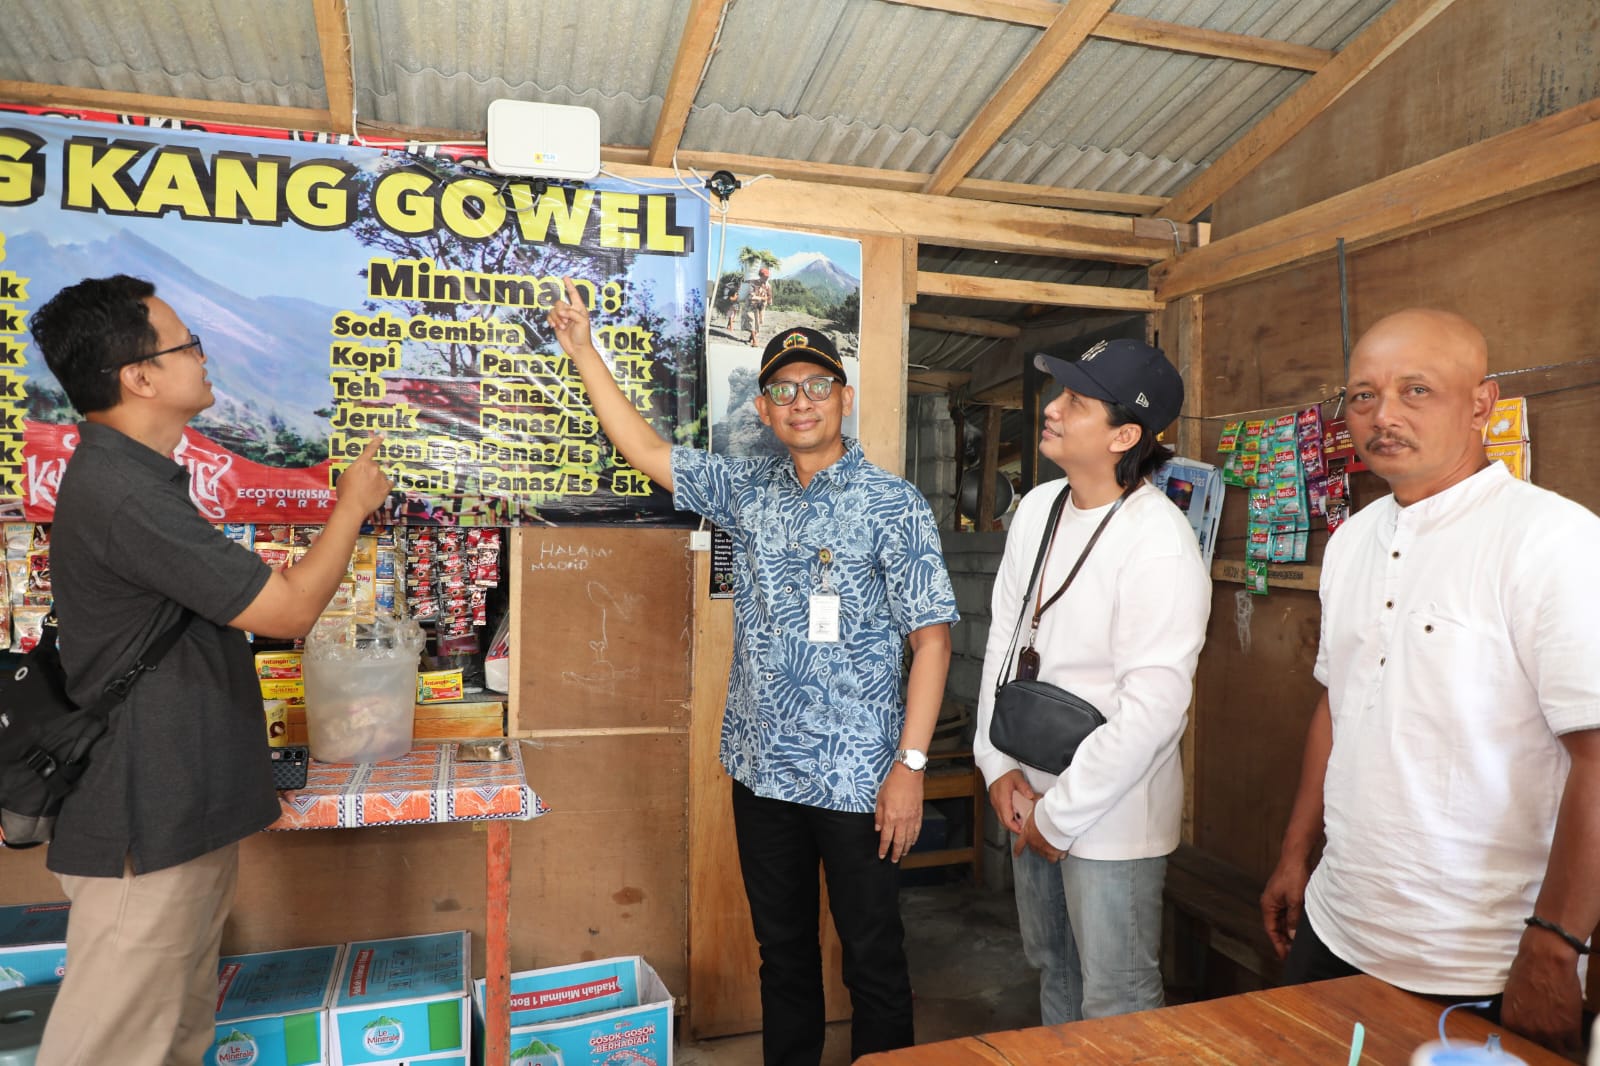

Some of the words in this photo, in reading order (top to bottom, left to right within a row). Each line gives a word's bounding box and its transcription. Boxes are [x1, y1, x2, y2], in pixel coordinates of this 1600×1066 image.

[64, 139, 352, 230] KANG
[374, 170, 688, 253] GOWEL
[334, 316, 401, 337] Soda
[409, 320, 520, 344] Gembira
[600, 331, 645, 351] 10k
[333, 347, 396, 372] Kopi
[482, 354, 580, 377] Panas/E
[614, 360, 646, 380] 5k
[333, 377, 381, 398] Teh
[333, 408, 412, 429] Jeruk
[482, 412, 594, 435] Panas/Es
[482, 443, 593, 465] Panas/Es
[482, 472, 593, 494] Panas/Es
[614, 477, 646, 494] 5k
[237, 488, 330, 500] ECOTOURISM
[356, 574, 370, 583] Day
[532, 995, 538, 1006] 1
[540, 986, 580, 1004] Minimal
[582, 981, 616, 1001] Hadiah
[378, 1029, 388, 1037] Le
[590, 1024, 656, 1046] GOSOK-GOSOK
[230, 1046, 241, 1054] Le
[596, 1035, 649, 1053] BERHADIAH
